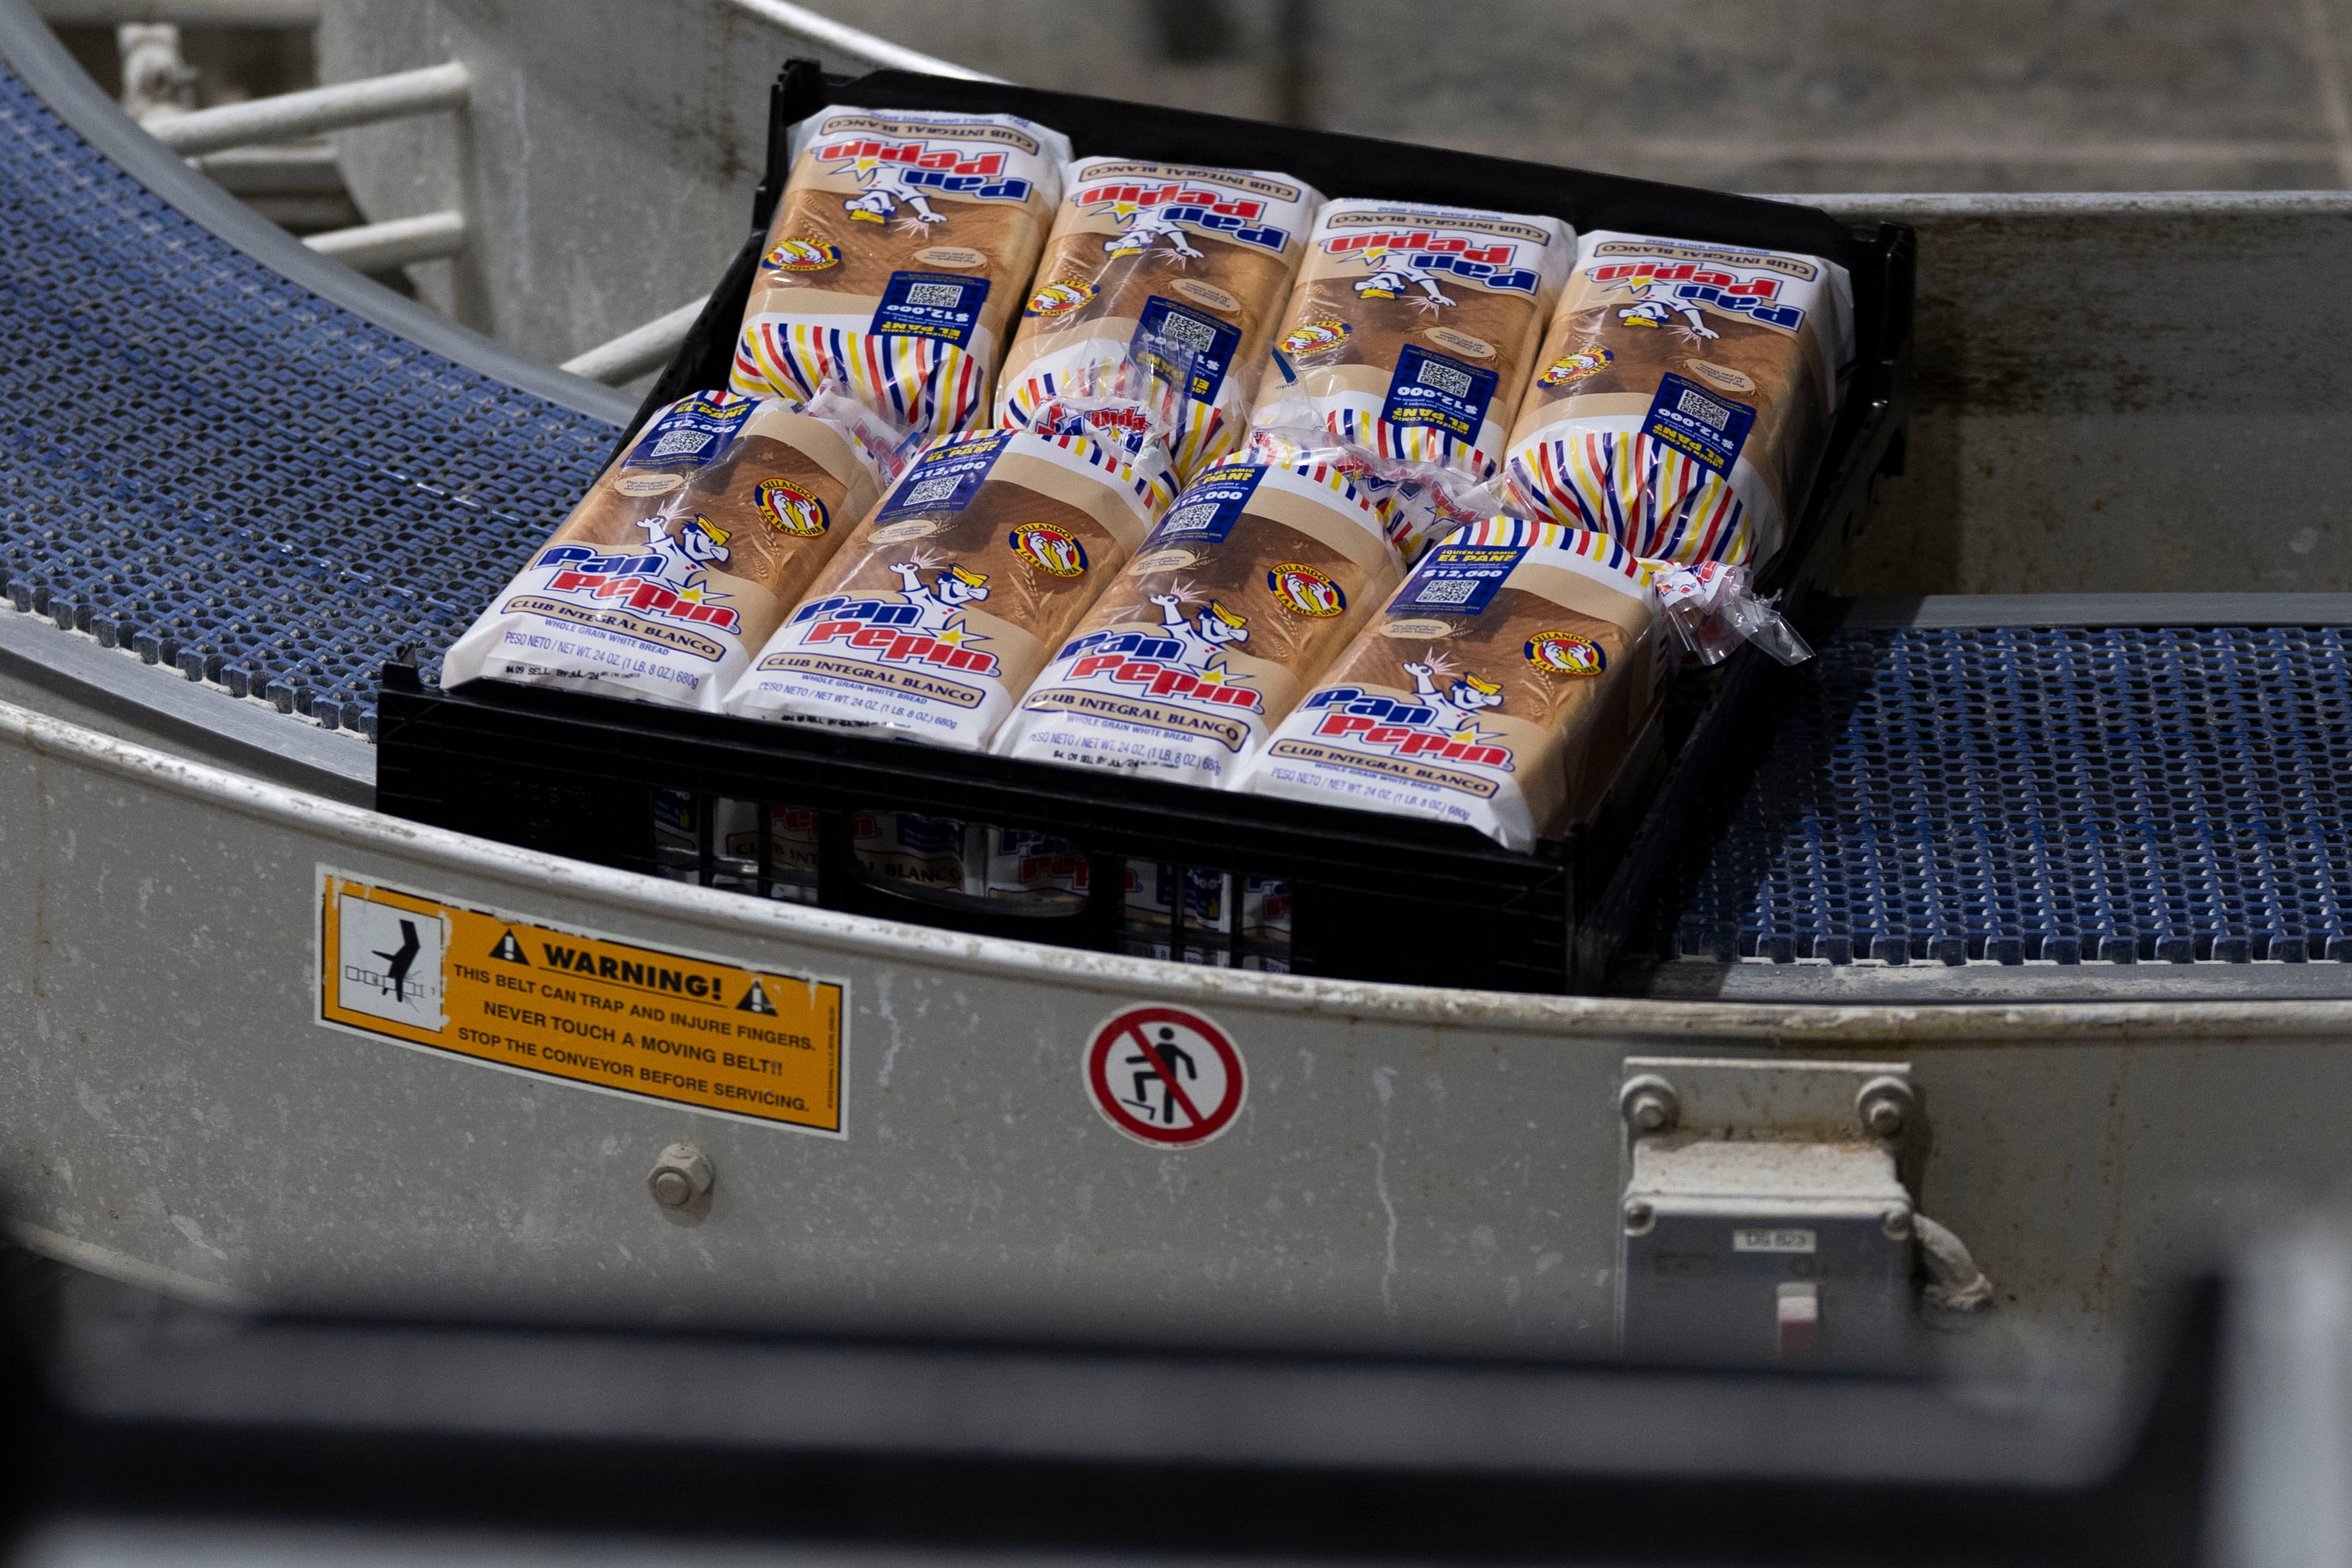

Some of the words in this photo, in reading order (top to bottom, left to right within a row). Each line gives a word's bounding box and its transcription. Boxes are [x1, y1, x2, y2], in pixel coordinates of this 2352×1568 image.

[828, 119, 899, 133] BLANCO
[904, 126, 985, 138] INTEGRAL
[820, 140, 1004, 175] Pepin
[1088, 165, 1157, 176] BLANCO
[903, 169, 1027, 198] Pan
[1161, 167, 1244, 186] INTEGRAL
[1249, 181, 1293, 196] CLUB
[1079, 184, 1260, 219] Pepin
[1162, 207, 1284, 249] Pan
[1335, 215, 1411, 225] BLANCO
[1415, 217, 1493, 230] INTEGRAL
[1499, 225, 1543, 238] CLUB
[1330, 232, 1512, 264] Pepin
[1603, 244, 1674, 255] BLANCO
[1680, 250, 1760, 265] INTEGRAL
[1412, 254, 1534, 292] Pan
[1596, 263, 1778, 298] Pepin
[1766, 259, 1810, 275] CLUB
[886, 304, 969, 323] $12,000
[1677, 285, 1801, 329] Pan
[882, 321, 934, 331] PAN?
[939, 327, 961, 337] EL
[697, 406, 748, 418] PAN?
[1397, 387, 1478, 414] $12,000
[658, 419, 737, 433] $12,000
[1393, 408, 1445, 421] PAN?
[1449, 417, 1470, 431] EL
[1654, 424, 1703, 451] PAN?
[1658, 408, 1734, 450] $12,000
[925, 453, 944, 463] EL
[948, 443, 997, 458] PAN?
[1706, 448, 1724, 466] EL
[910, 461, 986, 481] $12,000
[1202, 473, 1252, 484] PAN?
[762, 480, 813, 499] SELLANDO
[764, 510, 775, 520] LA
[775, 521, 822, 535] FRESCURA
[1017, 524, 1071, 539] SELLANDO
[536, 547, 666, 576] Pan
[1021, 551, 1032, 560] LA
[1034, 561, 1079, 576] FRESCURA
[1275, 565, 1327, 582] SELLANDO
[1422, 569, 1503, 578] $12,000
[550, 572, 737, 628] Pepin
[789, 597, 922, 625] Pan
[1278, 593, 1289, 604] LA
[1291, 605, 1339, 615] FRESCURA
[510, 600, 554, 612] CLUB
[558, 603, 639, 631] INTEGRAL
[644, 627, 716, 655] BLANCO
[545, 618, 576, 632] WHOLE
[578, 626, 606, 640] GRAIN
[608, 633, 638, 647] WHITE
[638, 642, 670, 656] BREAD
[1532, 633, 1588, 644] SELLANDO
[803, 620, 995, 672] Pepin
[1054, 632, 1184, 661] Pan
[504, 631, 527, 645] PESO
[527, 634, 552, 649] NETO
[557, 640, 574, 655] NET
[577, 643, 591, 657] WT.
[593, 649, 605, 661] 24
[606, 651, 620, 666] OZ.
[622, 659, 631, 670] (1
[632, 661, 647, 673] LB.
[649, 664, 656, 675] 8
[676, 671, 699, 690] 680g
[1549, 666, 1598, 674] FRESCURA
[766, 657, 811, 667] CLUB
[815, 661, 896, 683] INTEGRAL
[901, 677, 975, 702] BLANCO
[801, 674, 834, 685] WHOLE
[835, 680, 865, 691] GRAIN
[866, 686, 896, 697] WHITE
[897, 692, 928, 705] BREAD
[1069, 654, 1258, 709] Pepin
[759, 681, 783, 692] PESO
[783, 684, 809, 697] NETO
[815, 691, 832, 701] NET
[834, 693, 849, 705] WT.
[851, 697, 864, 707] 24
[865, 699, 878, 711] OZ.
[880, 703, 890, 713] (1
[891, 705, 905, 716] LB.
[907, 709, 914, 718] 8
[934, 715, 958, 730] 680g
[1302, 689, 1436, 725] Pan
[1067, 714, 1098, 727] WHOLE
[1101, 720, 1129, 731] GRAIN
[1132, 726, 1160, 737] WHITE
[1162, 732, 1194, 743] BREAD
[1079, 697, 1162, 721] INTEGRAL
[1167, 713, 1240, 742] BLANCO
[1050, 732, 1074, 747] NETO
[1081, 736, 1098, 749] NET
[1100, 739, 1115, 751] WT.
[1117, 741, 1129, 753] 24
[1131, 744, 1145, 756] OZ.
[1147, 747, 1157, 757] (1
[1158, 749, 1173, 761] LB.
[1175, 751, 1182, 763] 8
[1318, 714, 1509, 767] Pepin
[1271, 767, 1296, 780] PESO
[1297, 770, 1321, 785] NETO
[1329, 778, 1347, 790] NET
[1348, 780, 1364, 793] WT.
[1364, 784, 1376, 796] 24
[1279, 745, 1323, 757] CLUB
[1328, 751, 1410, 774] INTEGRAL
[1415, 768, 1489, 792] BLANCO
[542, 943, 721, 1001] WARNING!
[454, 963, 490, 983] THIS
[496, 974, 536, 994] BELT
[541, 985, 576, 1003] CAN
[579, 992, 624, 1013] TRAP
[630, 1004, 664, 1021] AND
[670, 1012, 731, 1035] INJURE
[737, 1025, 816, 1051] FINGERS.
[483, 1000, 546, 1027] NEVER
[550, 1016, 615, 1042] TOUCH
[622, 1032, 635, 1047] A
[641, 1035, 716, 1063] MOVING
[722, 1052, 783, 1076] BELT!!
[458, 1027, 501, 1046] STOP
[504, 1037, 537, 1056] THE
[541, 1047, 634, 1078] CONVEYOR
[640, 1067, 708, 1093] BEFORE
[714, 1082, 810, 1112] SERVICING.
